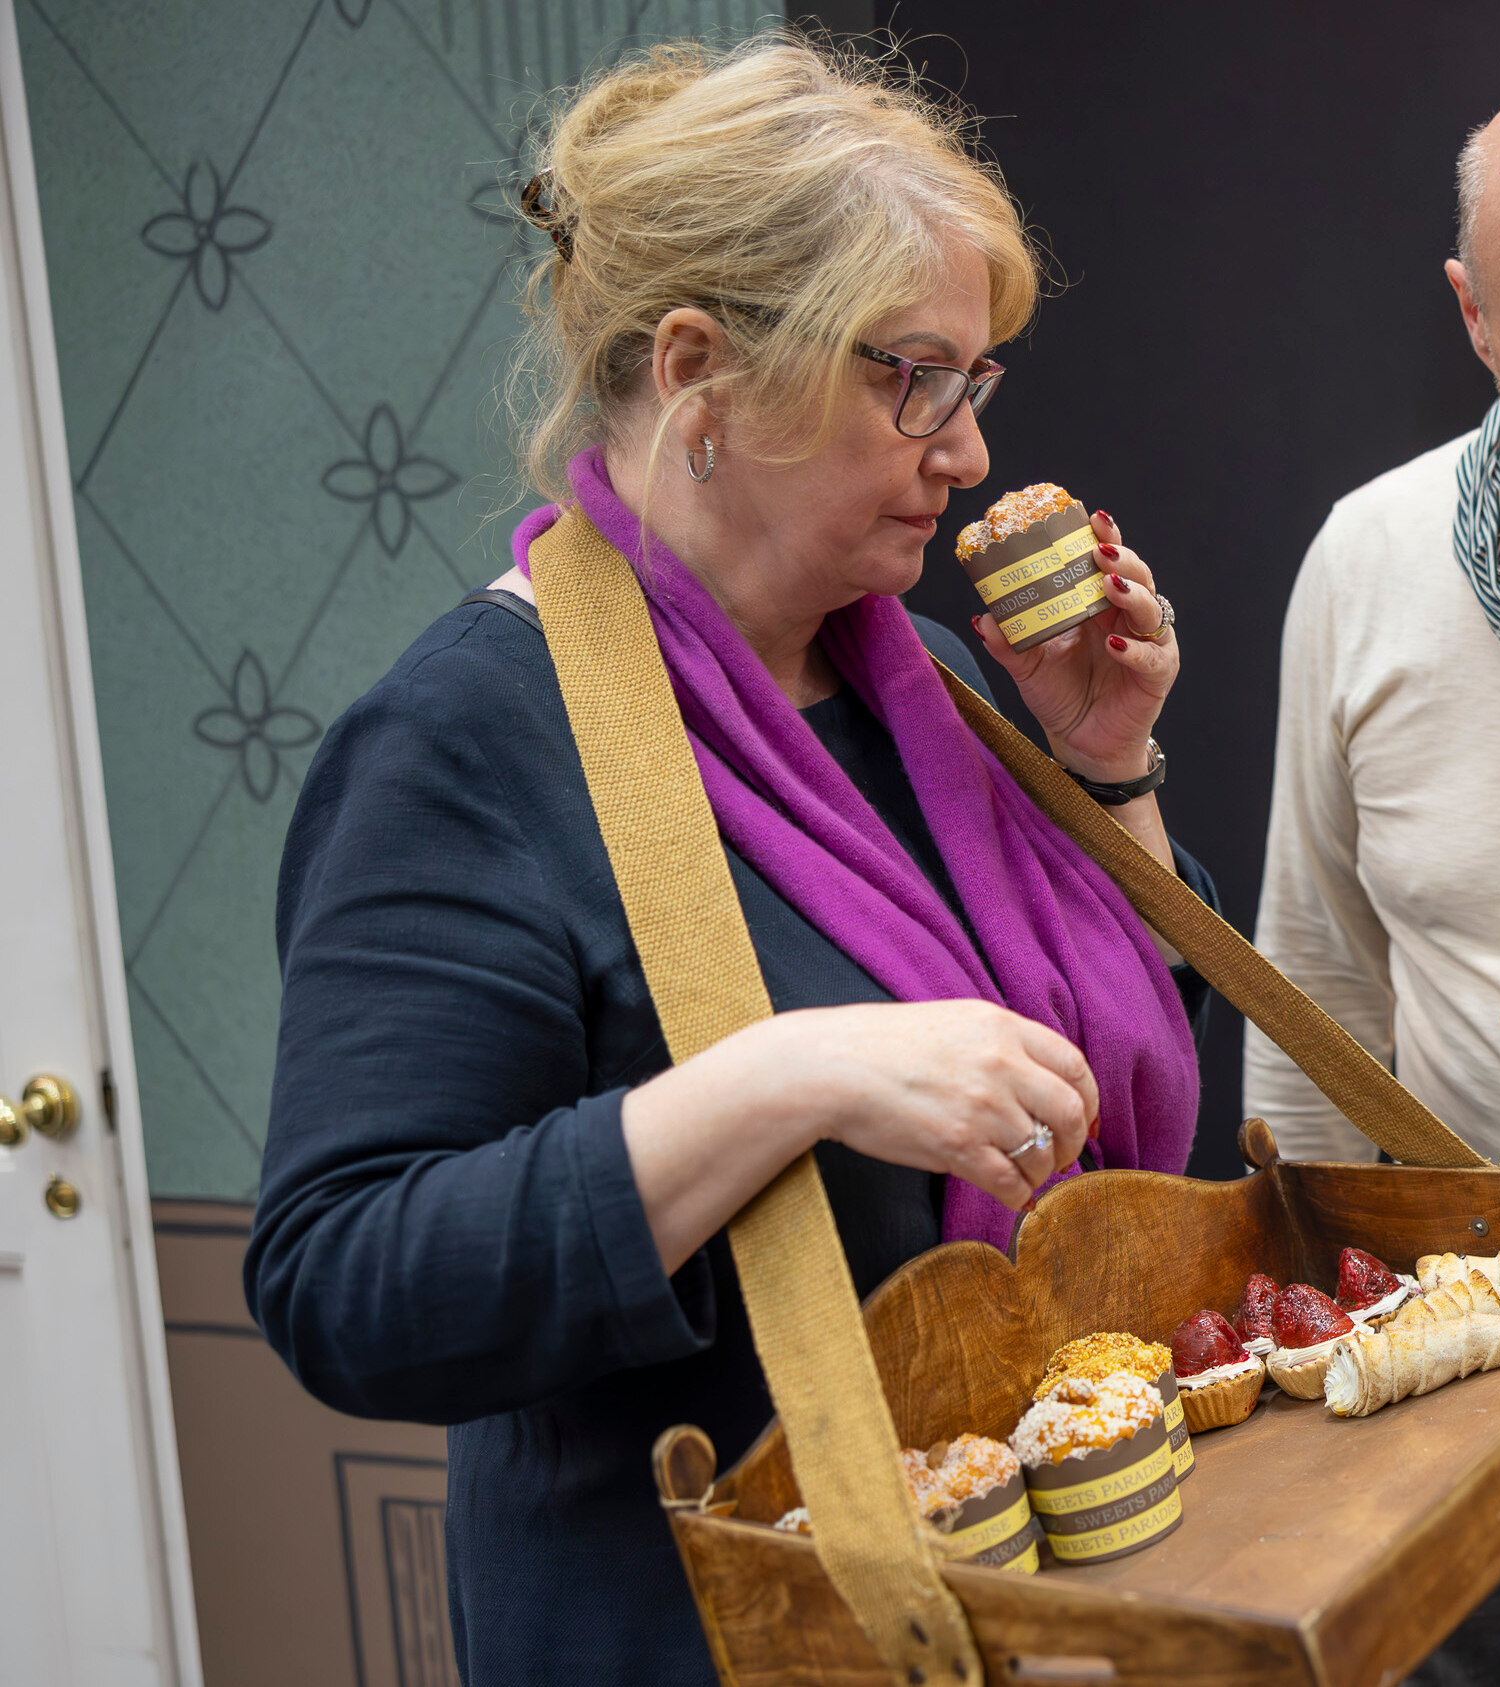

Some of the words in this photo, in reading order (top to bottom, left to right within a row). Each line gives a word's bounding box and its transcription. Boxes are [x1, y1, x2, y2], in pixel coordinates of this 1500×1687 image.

[999, 553, 1062, 587] SWEETS
[1053, 560, 1092, 588] SVISE
[1037, 592, 1083, 621] SWEE
[1075, 1491, 1146, 1530] SWEETS
